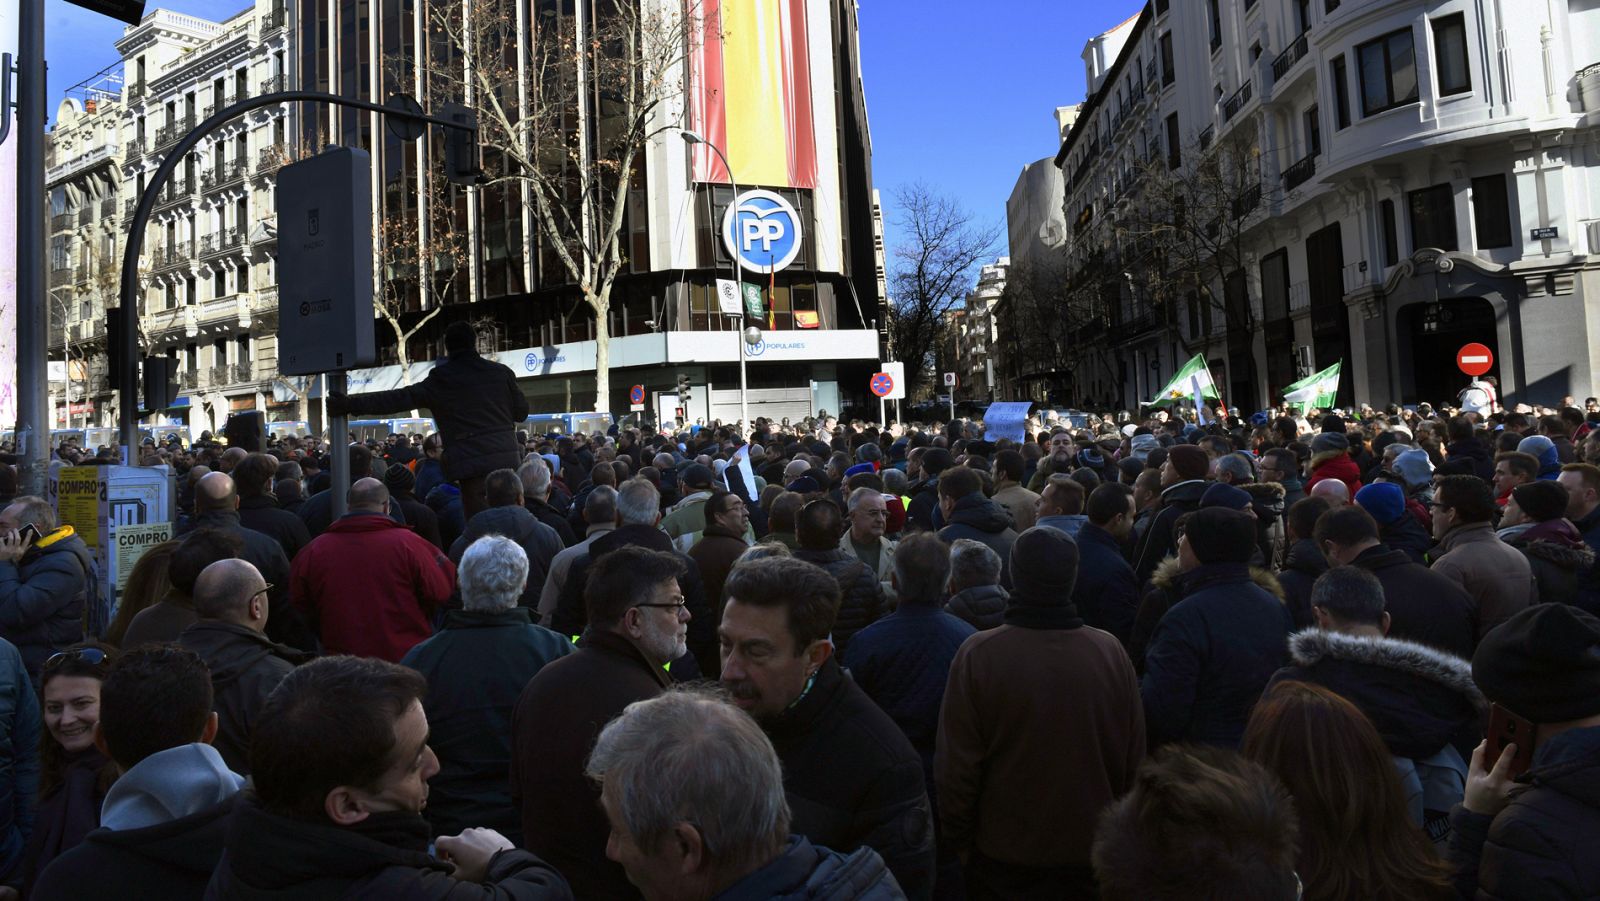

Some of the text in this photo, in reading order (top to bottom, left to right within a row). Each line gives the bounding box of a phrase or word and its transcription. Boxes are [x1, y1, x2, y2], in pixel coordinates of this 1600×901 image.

[742, 218, 785, 251] PP
[766, 342, 805, 350] POPULARES
[59, 480, 97, 495] COMPRO
[119, 532, 168, 546] COMPRO
